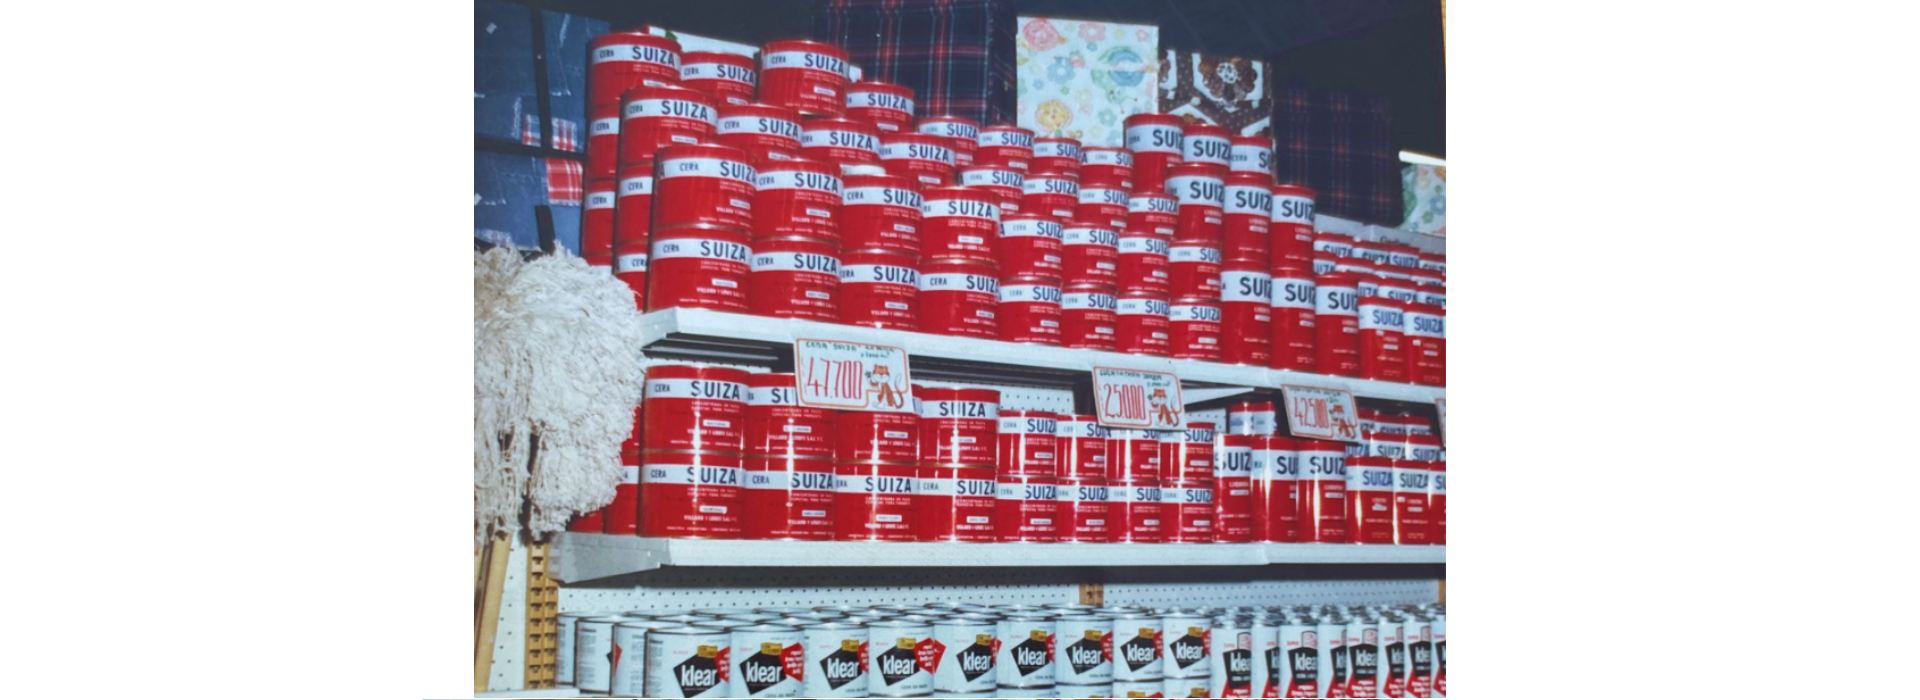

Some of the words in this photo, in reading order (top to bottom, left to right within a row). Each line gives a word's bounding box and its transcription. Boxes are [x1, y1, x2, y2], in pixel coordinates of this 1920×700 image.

[632, 46, 675, 67] SUIZA
[804, 54, 844, 74] SUIZA
[684, 67, 699, 77] CERA
[717, 65, 754, 82] SUIZA
[661, 100, 708, 121] SUIZA
[868, 94, 907, 111] SUIZA
[759, 119, 798, 137] SUIZA
[947, 124, 977, 138] SUIZA
[830, 132, 872, 150] SUIZA
[1001, 133, 1032, 146] SUIZA
[1153, 129, 1183, 150] SUIZ
[909, 146, 949, 162] SUIZA
[1194, 140, 1231, 160] SUIZ
[680, 163, 699, 171] CERA
[720, 161, 757, 183] SUIZA
[993, 172, 1023, 186] SUIZA
[759, 177, 774, 185] CERA
[795, 173, 838, 193] SUIZA
[1045, 180, 1077, 194] SUIZA
[1190, 181, 1224, 200] SUIZ
[847, 192, 863, 200] CERA
[884, 190, 921, 207] SUIZA
[1148, 199, 1177, 212] SUIZA
[1236, 191, 1272, 211] SUIZ
[949, 201, 992, 217] SUIZA
[1282, 200, 1314, 221] SUIZ
[663, 245, 679, 253] CERA
[701, 241, 746, 262] SUIZA
[758, 258, 774, 266] CERA
[794, 254, 837, 273] SUIZA
[874, 266, 916, 284] SUIZA
[930, 278, 947, 286] CERA
[1240, 276, 1271, 298] SUIZ
[1285, 284, 1316, 305] SUIZ
[1191, 307, 1219, 321] SUIZA
[1373, 310, 1403, 326] SUIZA
[1414, 317, 1443, 333] SUIZA
[807, 357, 862, 399] 47700
[655, 384, 670, 393] CERA
[691, 381, 740, 400] SUIZA
[939, 401, 986, 418] SUIZA
[1104, 383, 1146, 420] 25000
[1310, 456, 1346, 475] SUIZ
[651, 469, 666, 478] CERA
[687, 467, 737, 485] SUIZA
[752, 475, 770, 484] CERA
[791, 473, 833, 490] SUIZA
[865, 477, 911, 493] SUIZA
[1363, 470, 1393, 486] SUIZA
[1400, 473, 1428, 488] SUIZA
[923, 482, 938, 490] CERA
[957, 480, 995, 495] SUIZA
[1025, 485, 1056, 500] SUIZA
[1018, 647, 1047, 665] klear
[1072, 646, 1102, 664] klear
[1127, 644, 1155, 661] klear
[1176, 642, 1203, 659] klear
[828, 658, 859, 678] klear
[883, 655, 916, 674] klear
[964, 652, 991, 671] klear
[681, 665, 717, 686] klear
[746, 661, 783, 682] klear
